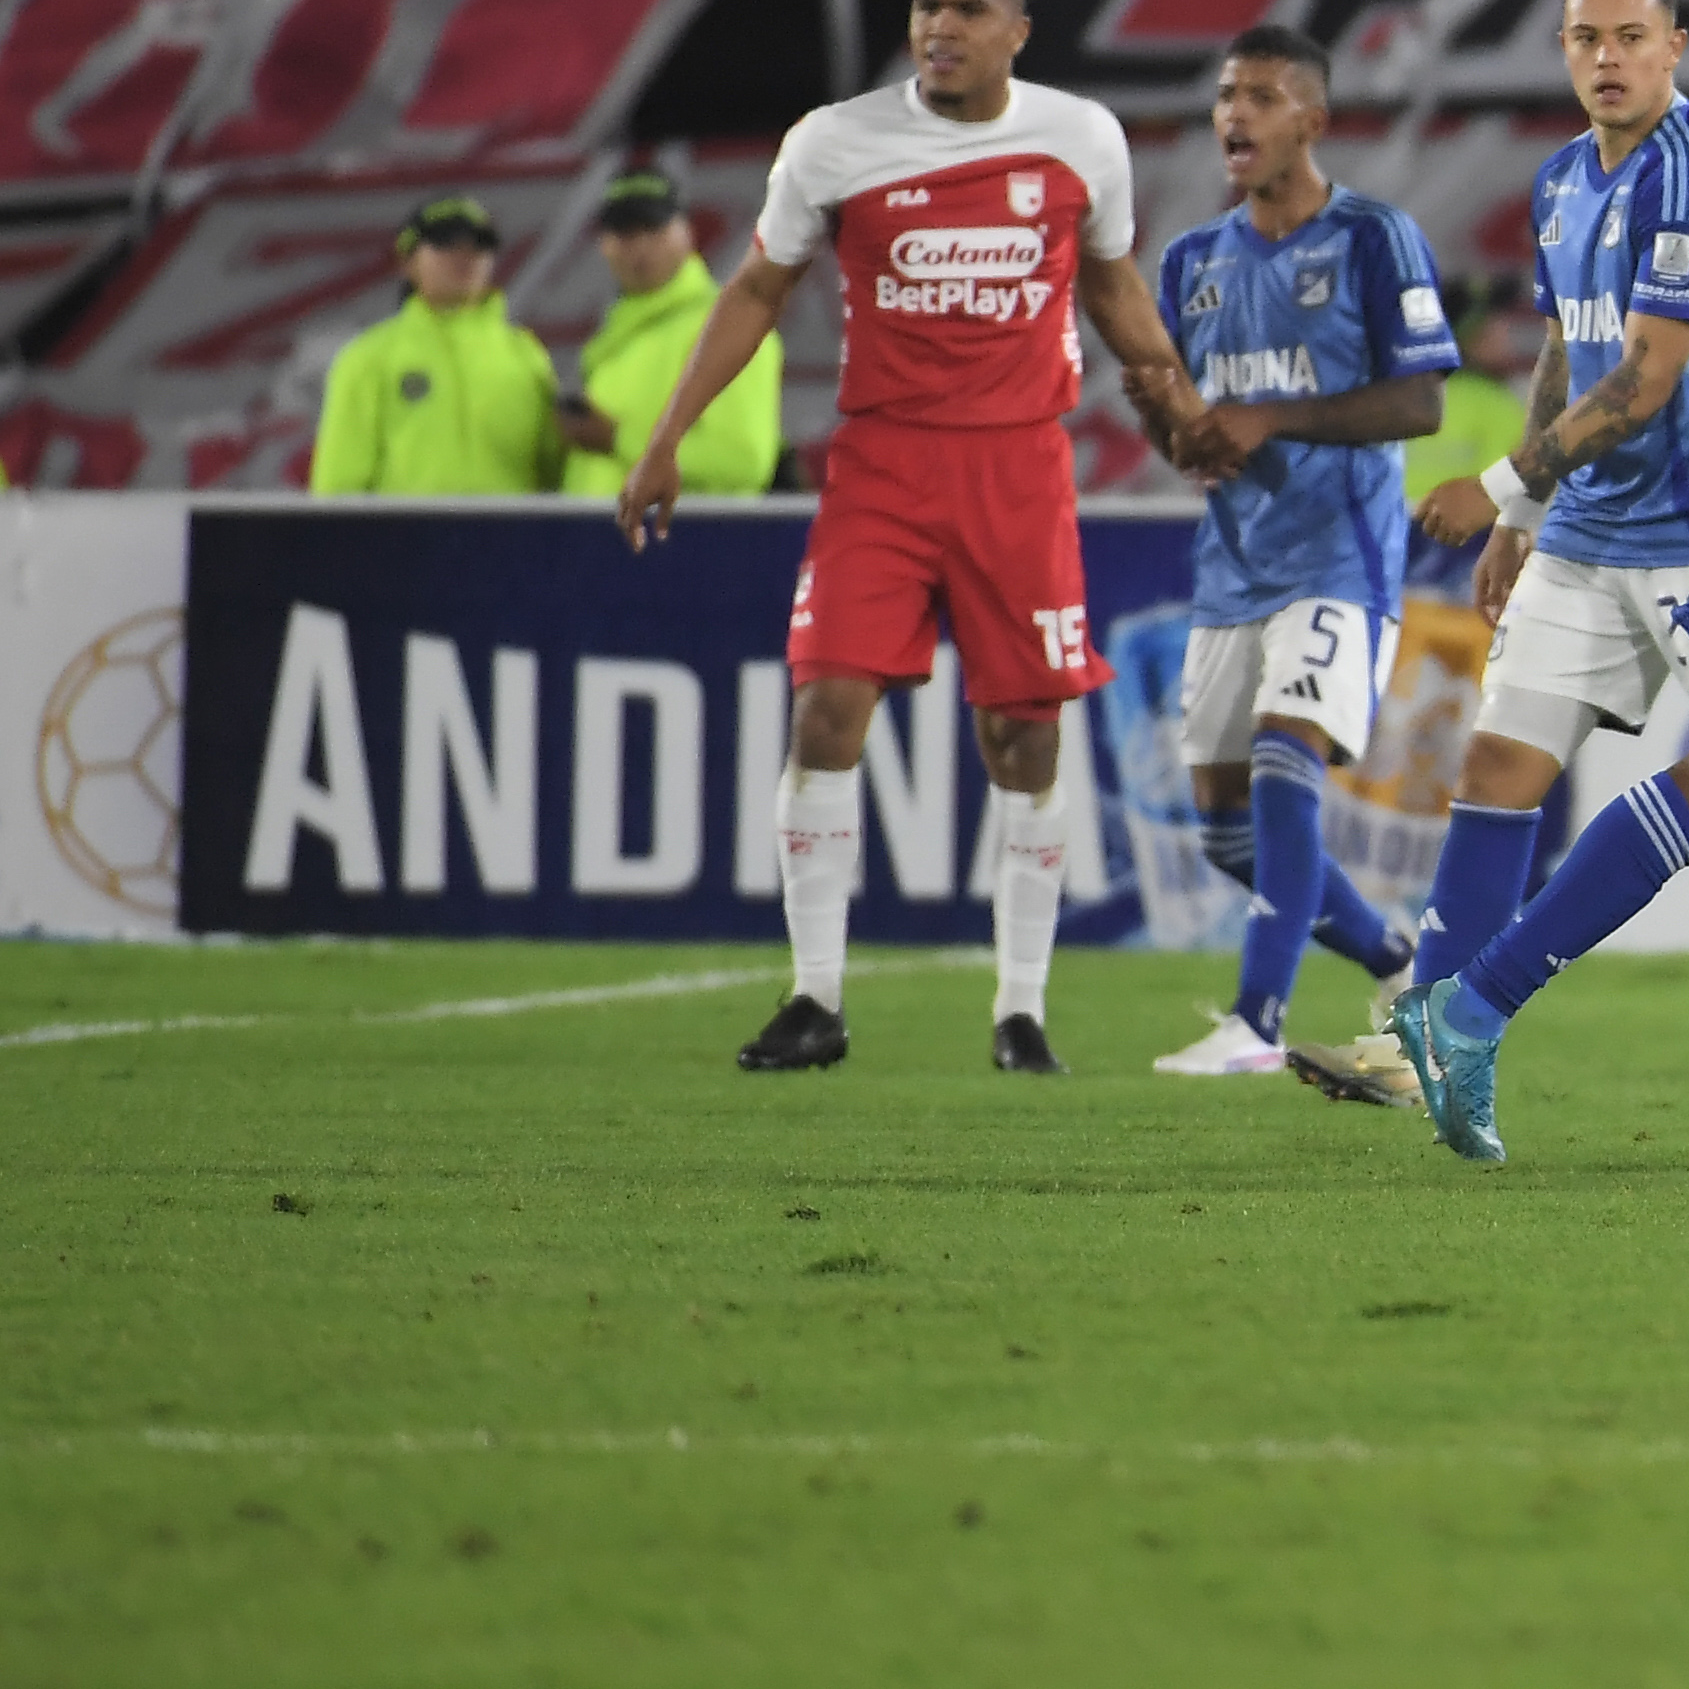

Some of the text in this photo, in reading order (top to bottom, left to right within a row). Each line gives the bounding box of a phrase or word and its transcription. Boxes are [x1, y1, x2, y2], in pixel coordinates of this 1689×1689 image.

[885, 187, 931, 210] FILA
[897, 238, 1038, 268] Colanta
[875, 275, 1019, 322] BetPlay
[1031, 604, 1087, 670] 15
[1302, 604, 1345, 668] 5
